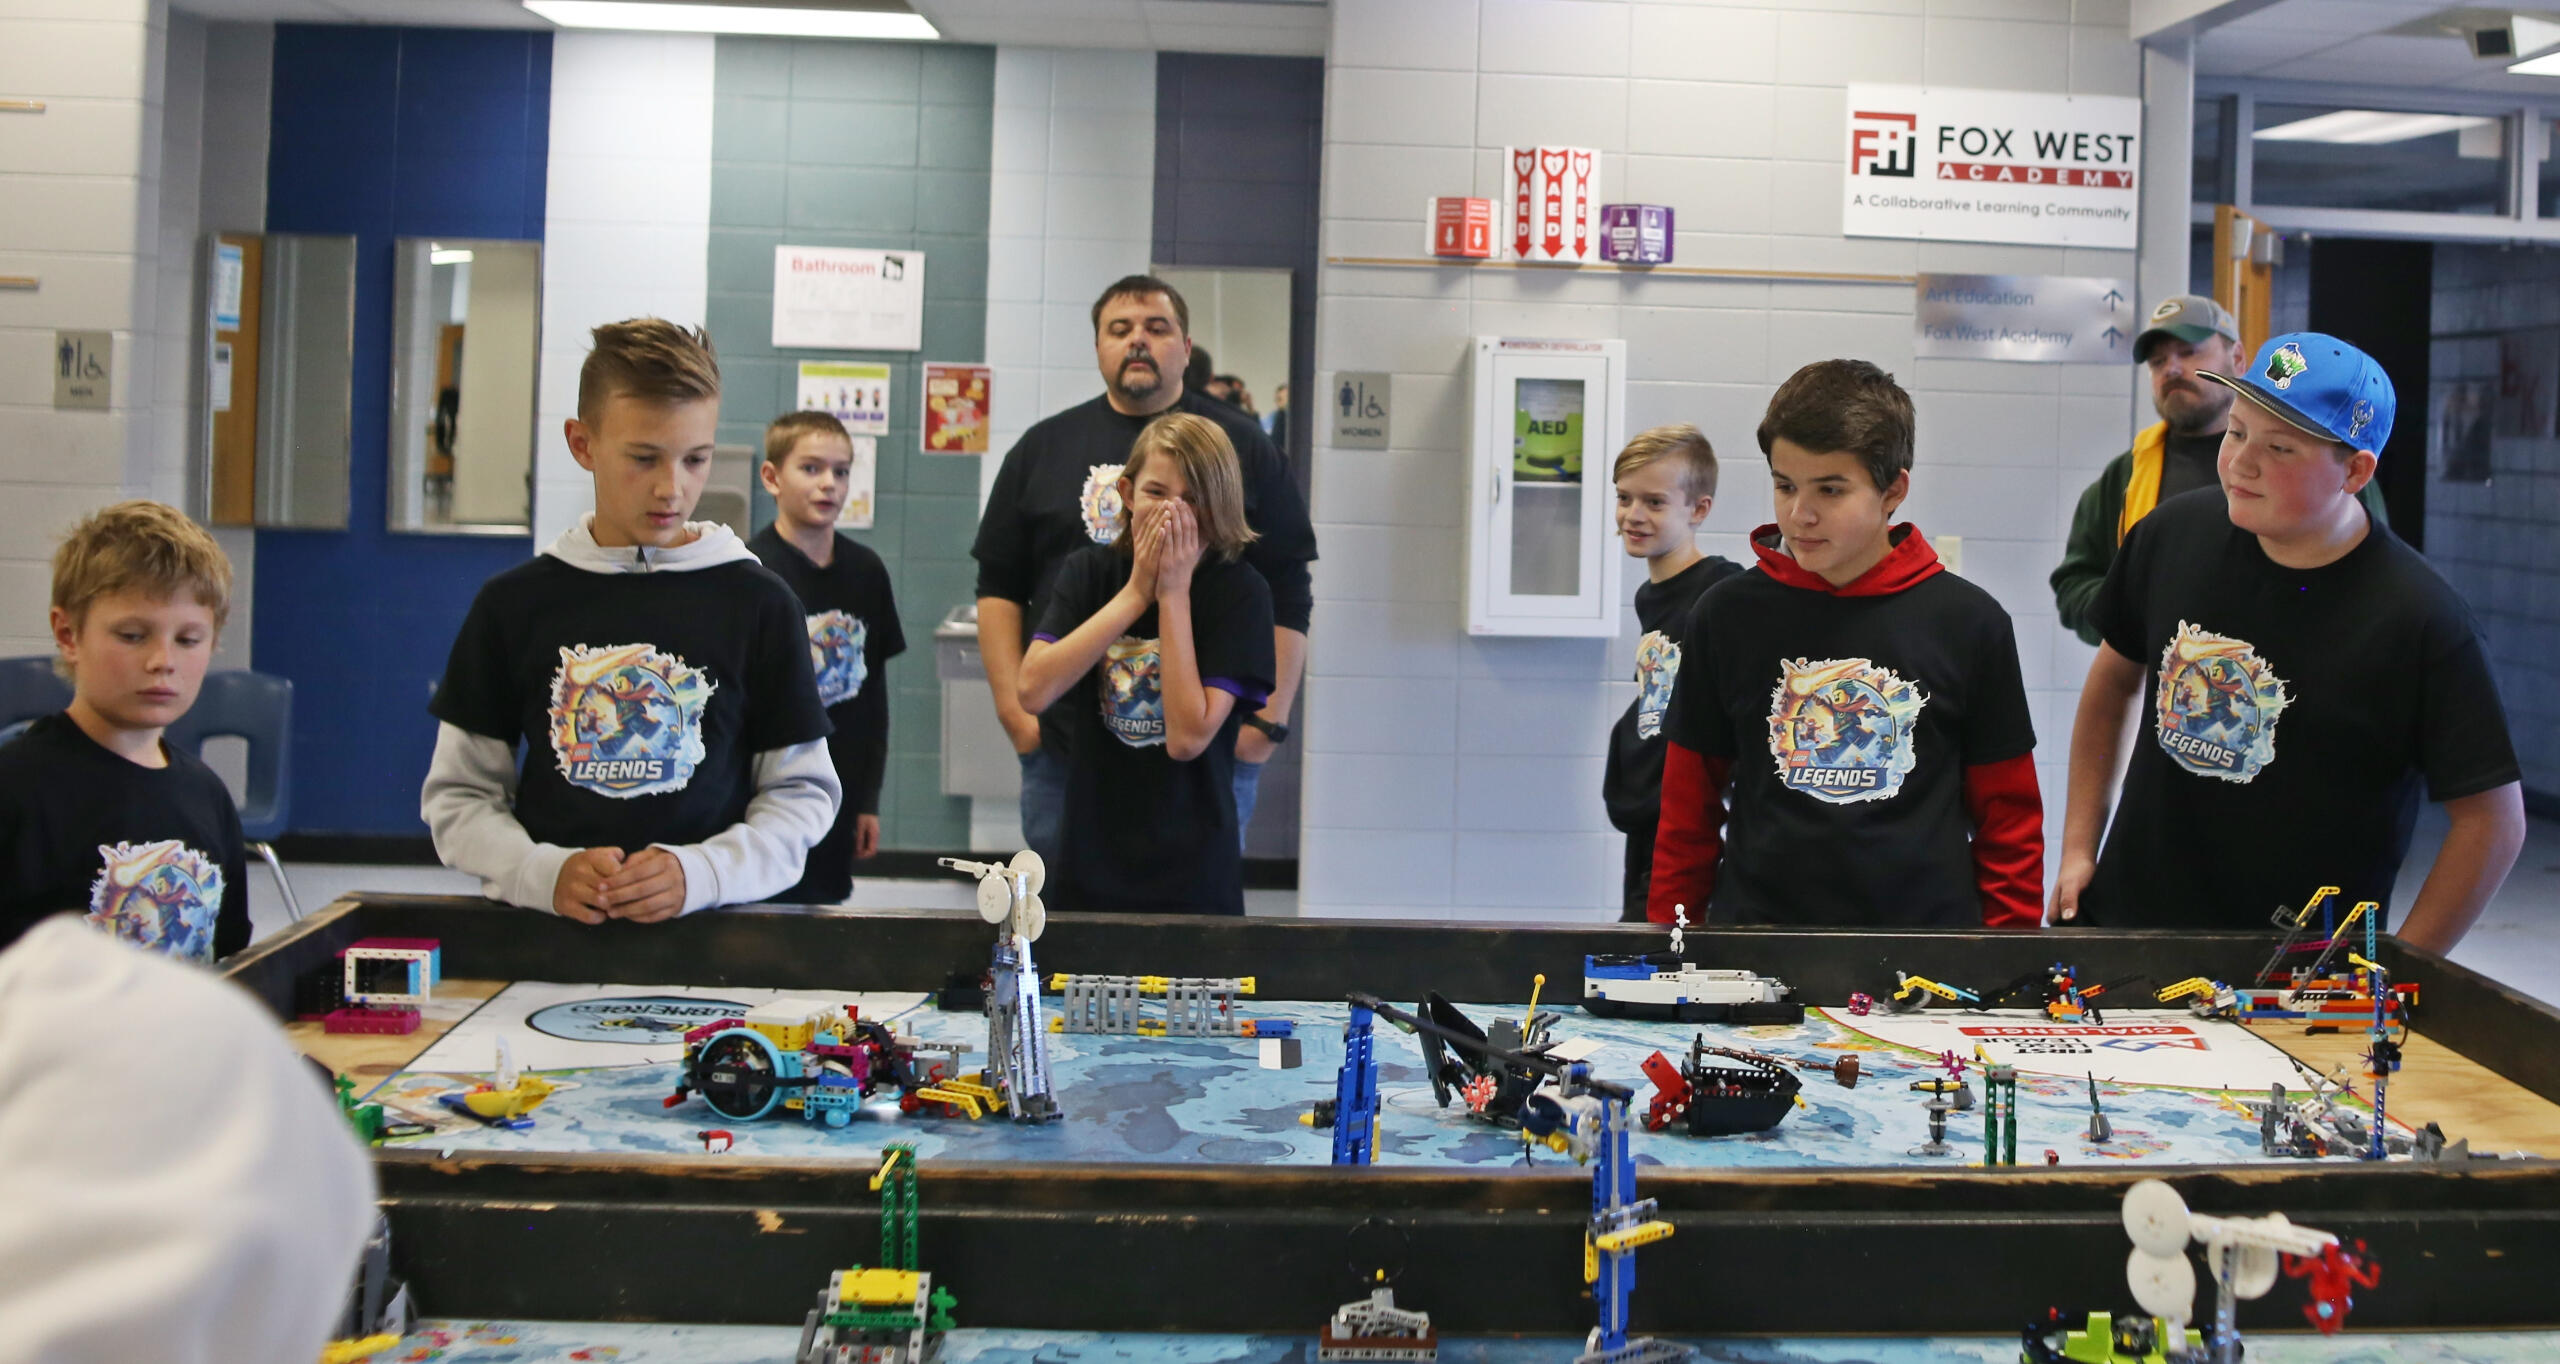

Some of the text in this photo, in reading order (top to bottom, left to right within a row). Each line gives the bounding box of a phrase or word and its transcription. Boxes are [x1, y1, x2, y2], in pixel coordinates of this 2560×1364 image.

[1938, 126, 2134, 163] FOX WEST
[1938, 163, 2133, 187] ACADEMY
[1546, 181, 1561, 237] AED
[1853, 194, 2131, 221] A Collaborative Learning Community
[792, 257, 876, 275] Bathroom
[1926, 288, 2035, 305] Art Education
[1924, 325, 2073, 347] Fox West Academy
[1341, 427, 1382, 437] WOMEN
[1527, 420, 1568, 436] AED
[1109, 715, 1163, 734] LEGENDS
[2163, 729, 2237, 768] LEGENDS
[574, 760, 664, 780] LEGENDS
[1792, 768, 1877, 788] LEGENDS
